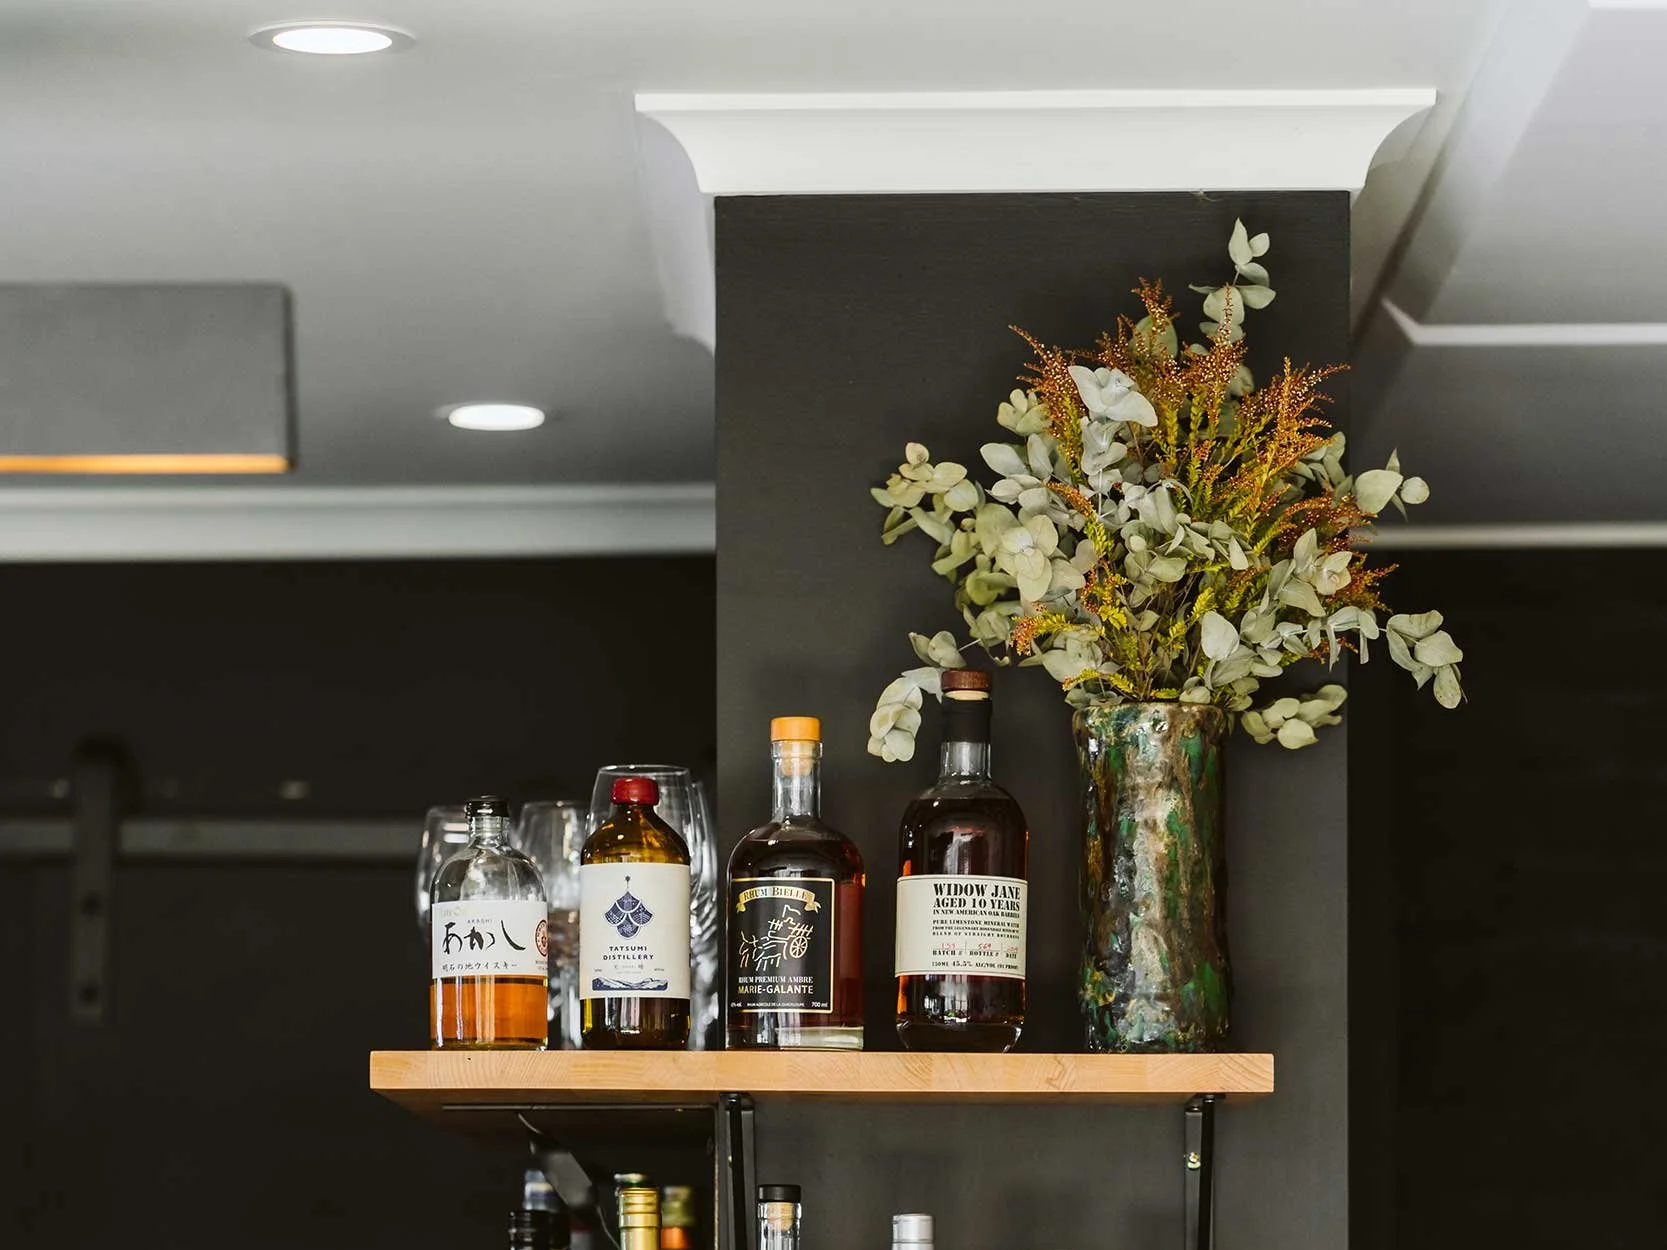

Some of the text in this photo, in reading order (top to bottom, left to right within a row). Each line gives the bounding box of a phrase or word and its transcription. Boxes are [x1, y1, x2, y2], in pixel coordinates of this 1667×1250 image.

[743, 888, 768, 900] RHUM
[933, 883, 1020, 900] WIDOW JANE
[933, 898, 1020, 912] AGED 10 YEARS
[754, 976, 786, 984] PREMIUM
[787, 976, 814, 984] AMBRE
[737, 985, 814, 994] MARIE-GALANTE
